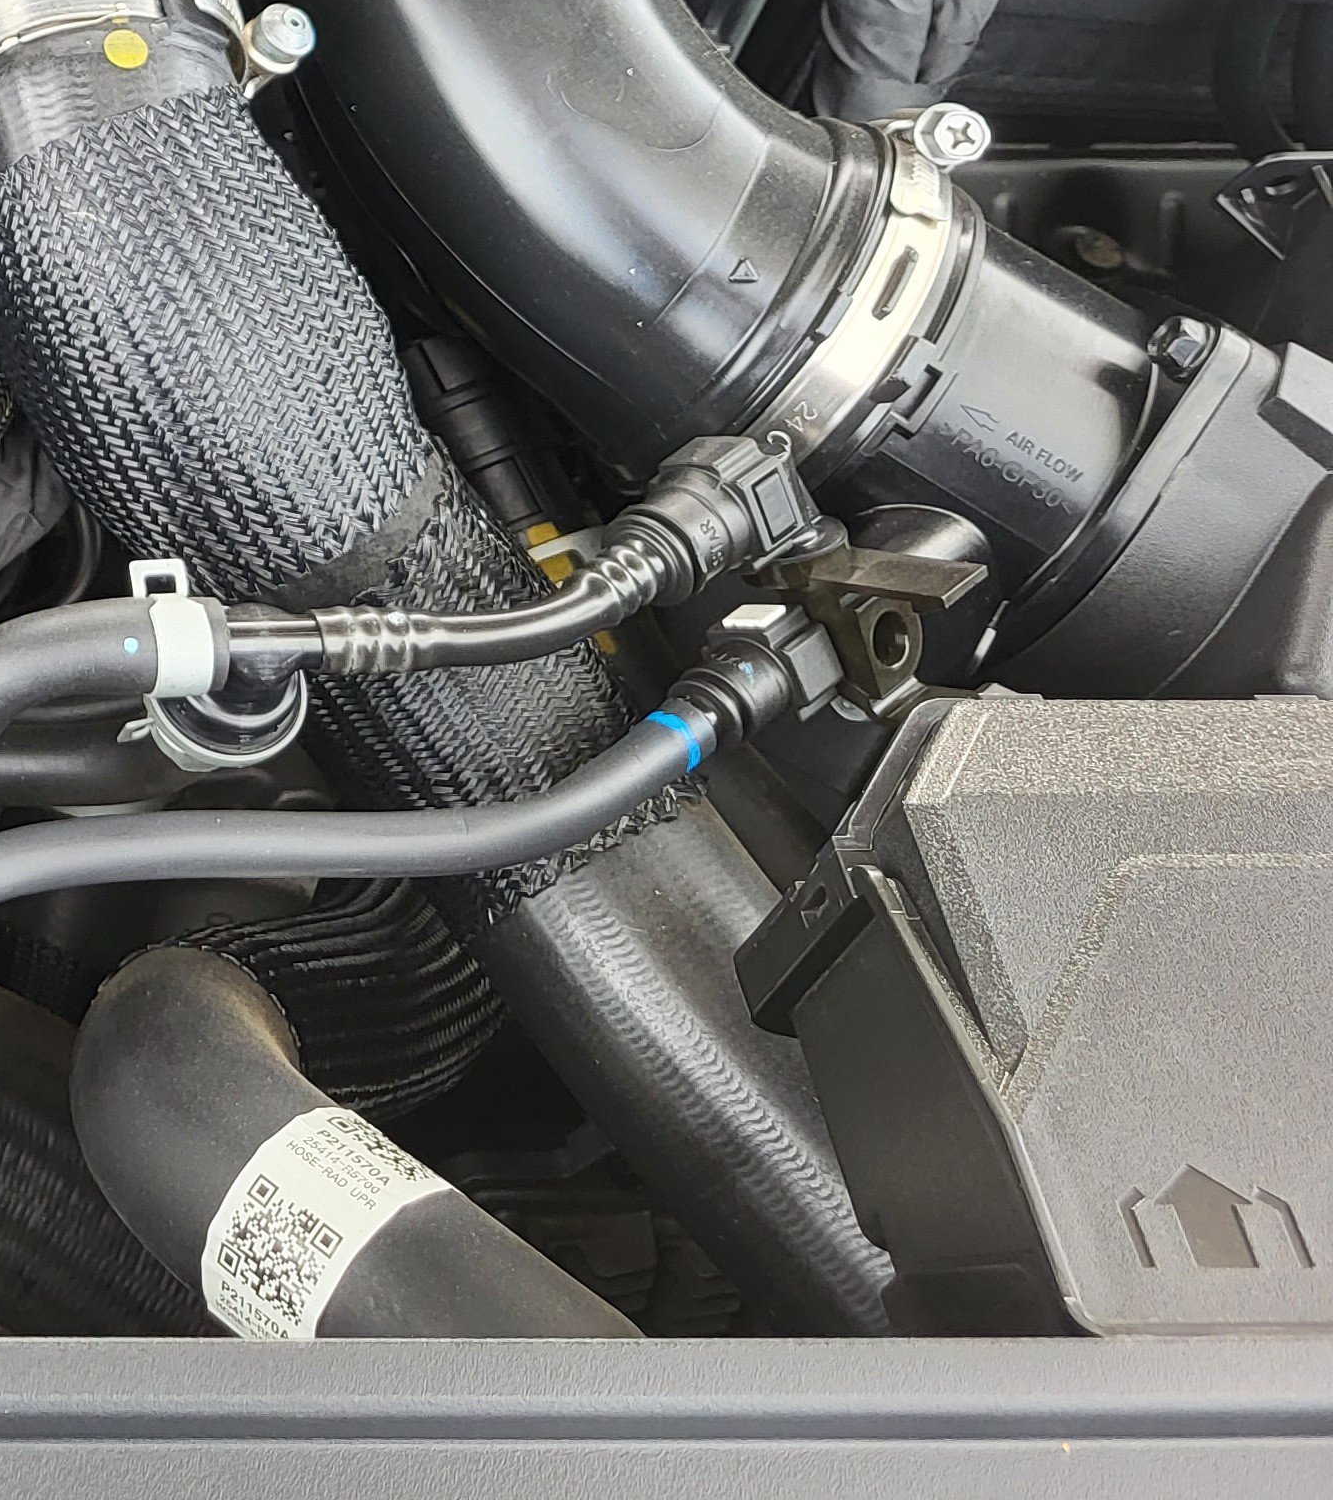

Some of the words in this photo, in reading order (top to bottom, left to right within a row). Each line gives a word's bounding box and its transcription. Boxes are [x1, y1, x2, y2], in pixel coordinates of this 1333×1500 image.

[789, 400, 819, 434] 24
[1005, 429, 1034, 457] AIR
[1034, 447, 1086, 484] FLOW
[285, 1139, 349, 1188] HOSE-RAD
[349, 1187, 377, 1211] UPR
[303, 1135, 381, 1195] 25414-R5700
[316, 1128, 391, 1187] P211570A
[220, 1279, 290, 1340] P211570A
